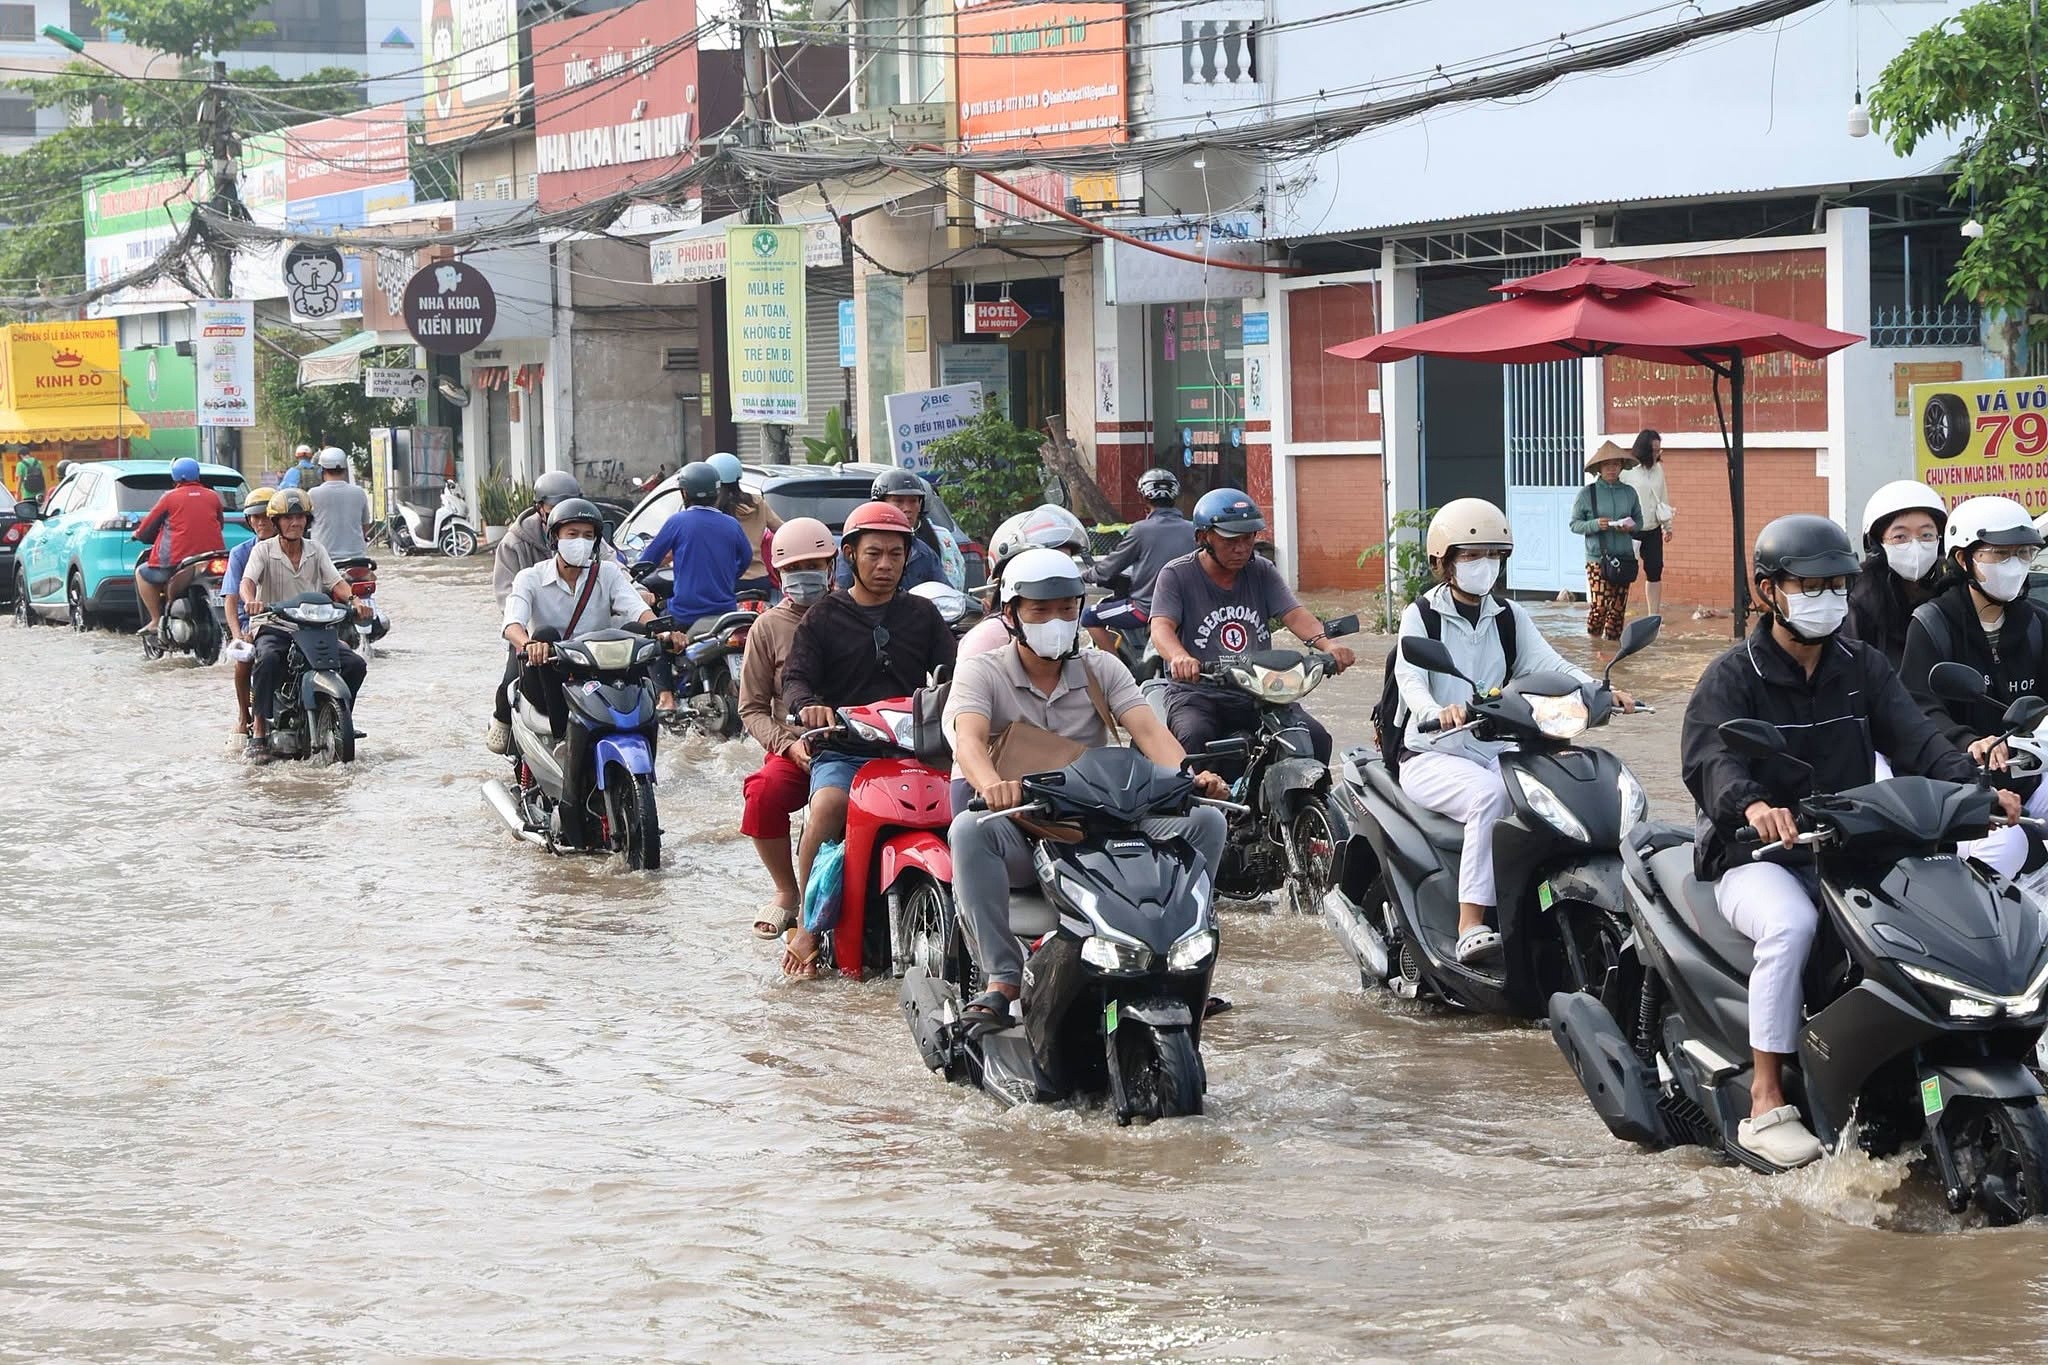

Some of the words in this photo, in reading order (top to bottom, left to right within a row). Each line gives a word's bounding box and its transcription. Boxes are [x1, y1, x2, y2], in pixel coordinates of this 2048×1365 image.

[536, 132, 569, 174] NHA
[570, 125, 614, 170] KHOA
[653, 112, 690, 158] HUY
[418, 296, 444, 310] NHA
[448, 296, 481, 310] KHOA
[744, 304, 758, 318] AN
[978, 306, 1018, 317] HOTEL
[418, 313, 451, 335] KIẾN
[455, 318, 483, 335] HUY
[82, 329, 106, 339] TRUNG
[743, 323, 776, 340] KHÔNG
[766, 348, 779, 360] EM
[36, 375, 74, 388] KINH
[776, 399, 797, 408] XANH
[1976, 389, 2009, 412] VÁ
[2016, 384, 2047, 410] VỎ
[946, 418, 957, 429] ĐA
[1975, 412, 2048, 459] 79
[1926, 464, 1962, 486] CHUYÊN
[1964, 465, 1984, 483] MUA
[2009, 462, 2033, 480] TRAO
